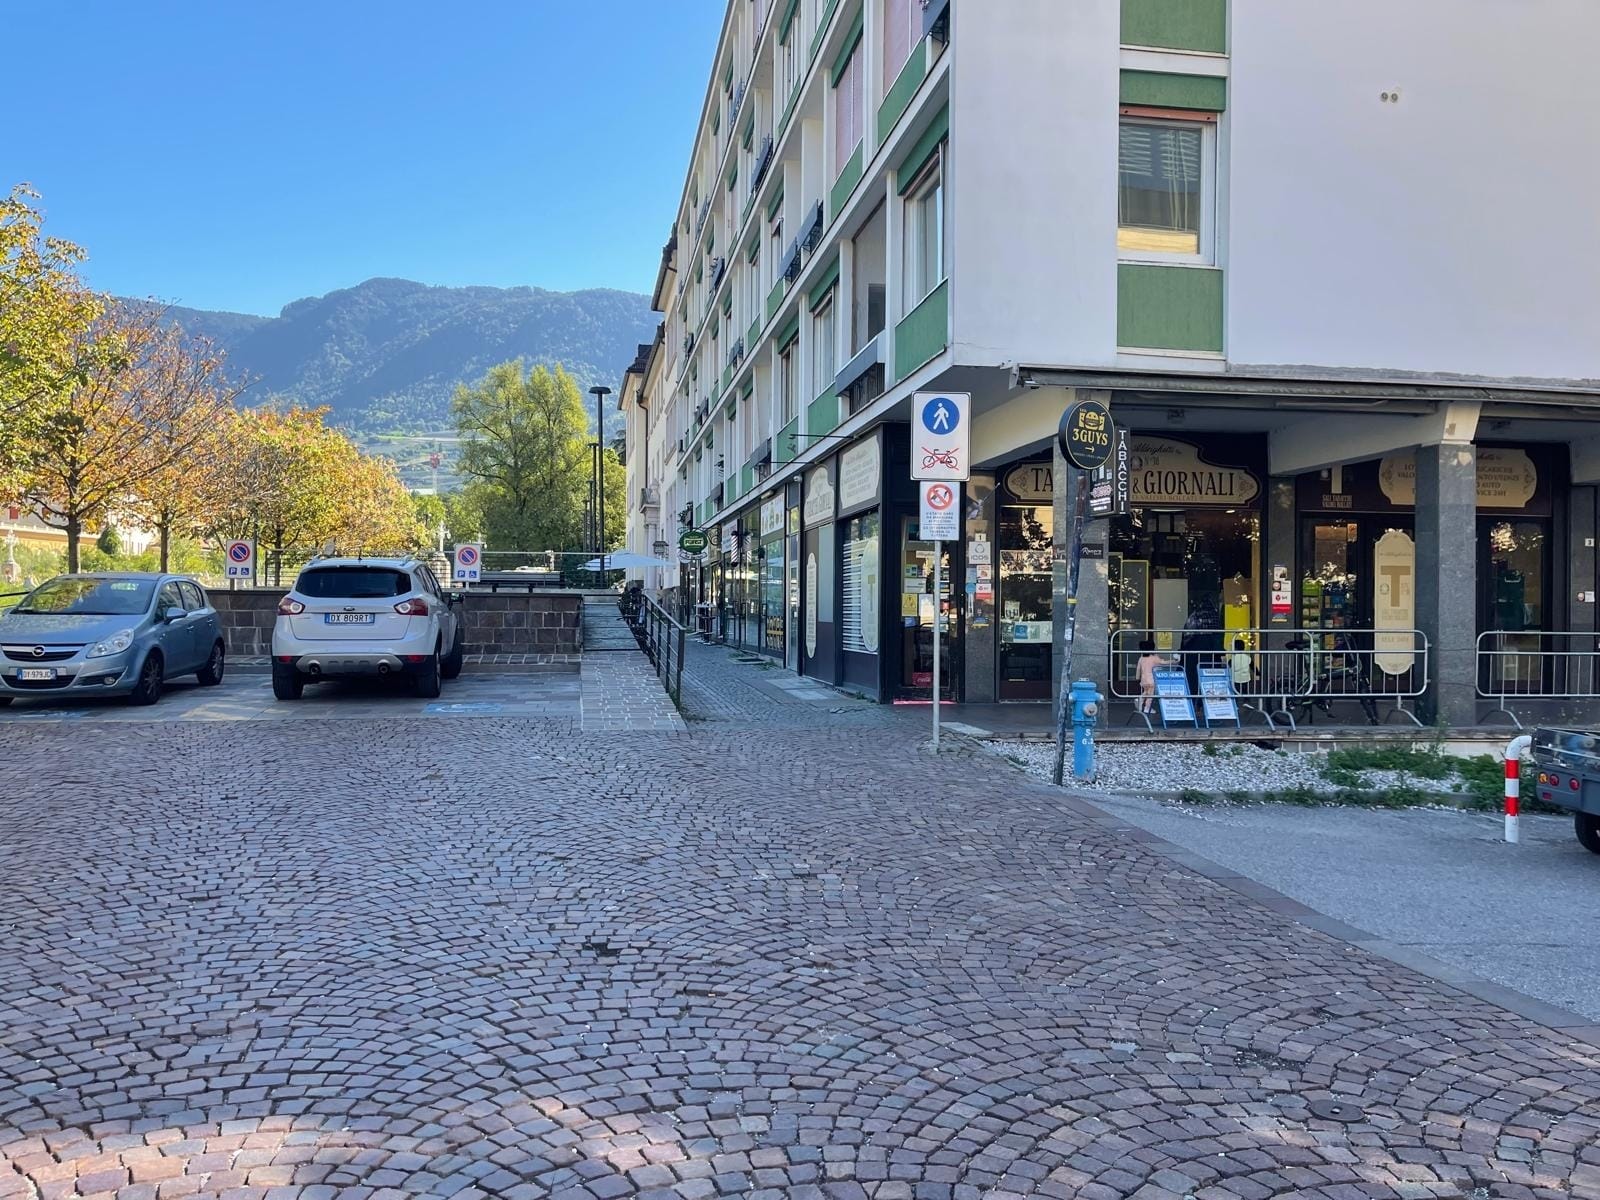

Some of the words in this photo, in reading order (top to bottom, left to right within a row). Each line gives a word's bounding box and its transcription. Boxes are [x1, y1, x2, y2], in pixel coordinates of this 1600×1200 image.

[1072, 428, 1108, 446] 3GUYS
[1031, 468, 1053, 492] TA
[1132, 478, 1141, 494] &
[1143, 470, 1234, 496] GIORNALI
[1118, 430, 1127, 515] TABACCHI
[1380, 565, 1411, 607] T
[343, 614, 369, 622] 809RT
